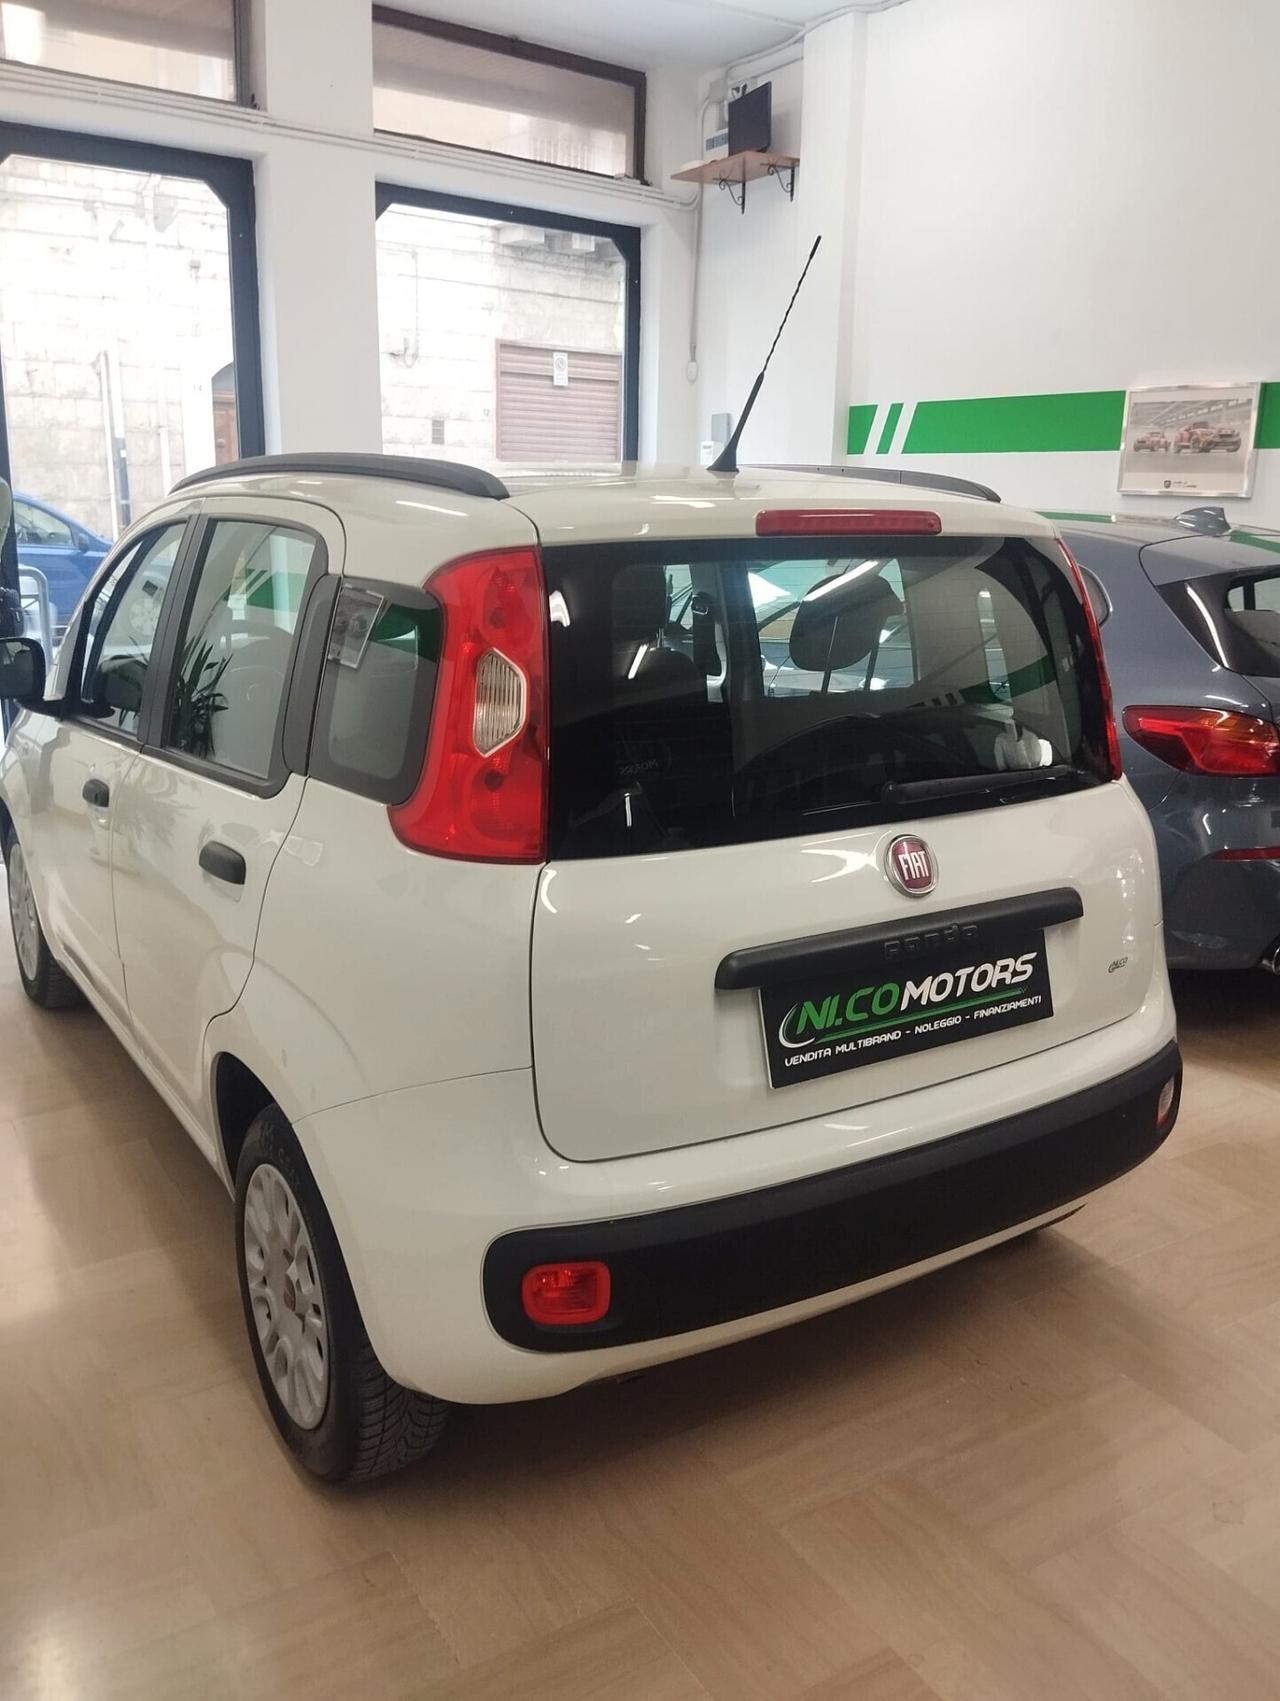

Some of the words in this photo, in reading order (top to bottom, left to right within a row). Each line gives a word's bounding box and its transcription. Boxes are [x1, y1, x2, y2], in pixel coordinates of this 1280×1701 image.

[898, 850, 929, 881] FIAT
[784, 1047, 832, 1067] VENDITA
[835, 1030, 902, 1055] MULTIBRAND
[914, 1015, 962, 1035] NOLEGGIO
[973, 995, 1042, 1020] FINANZIAMENTI
